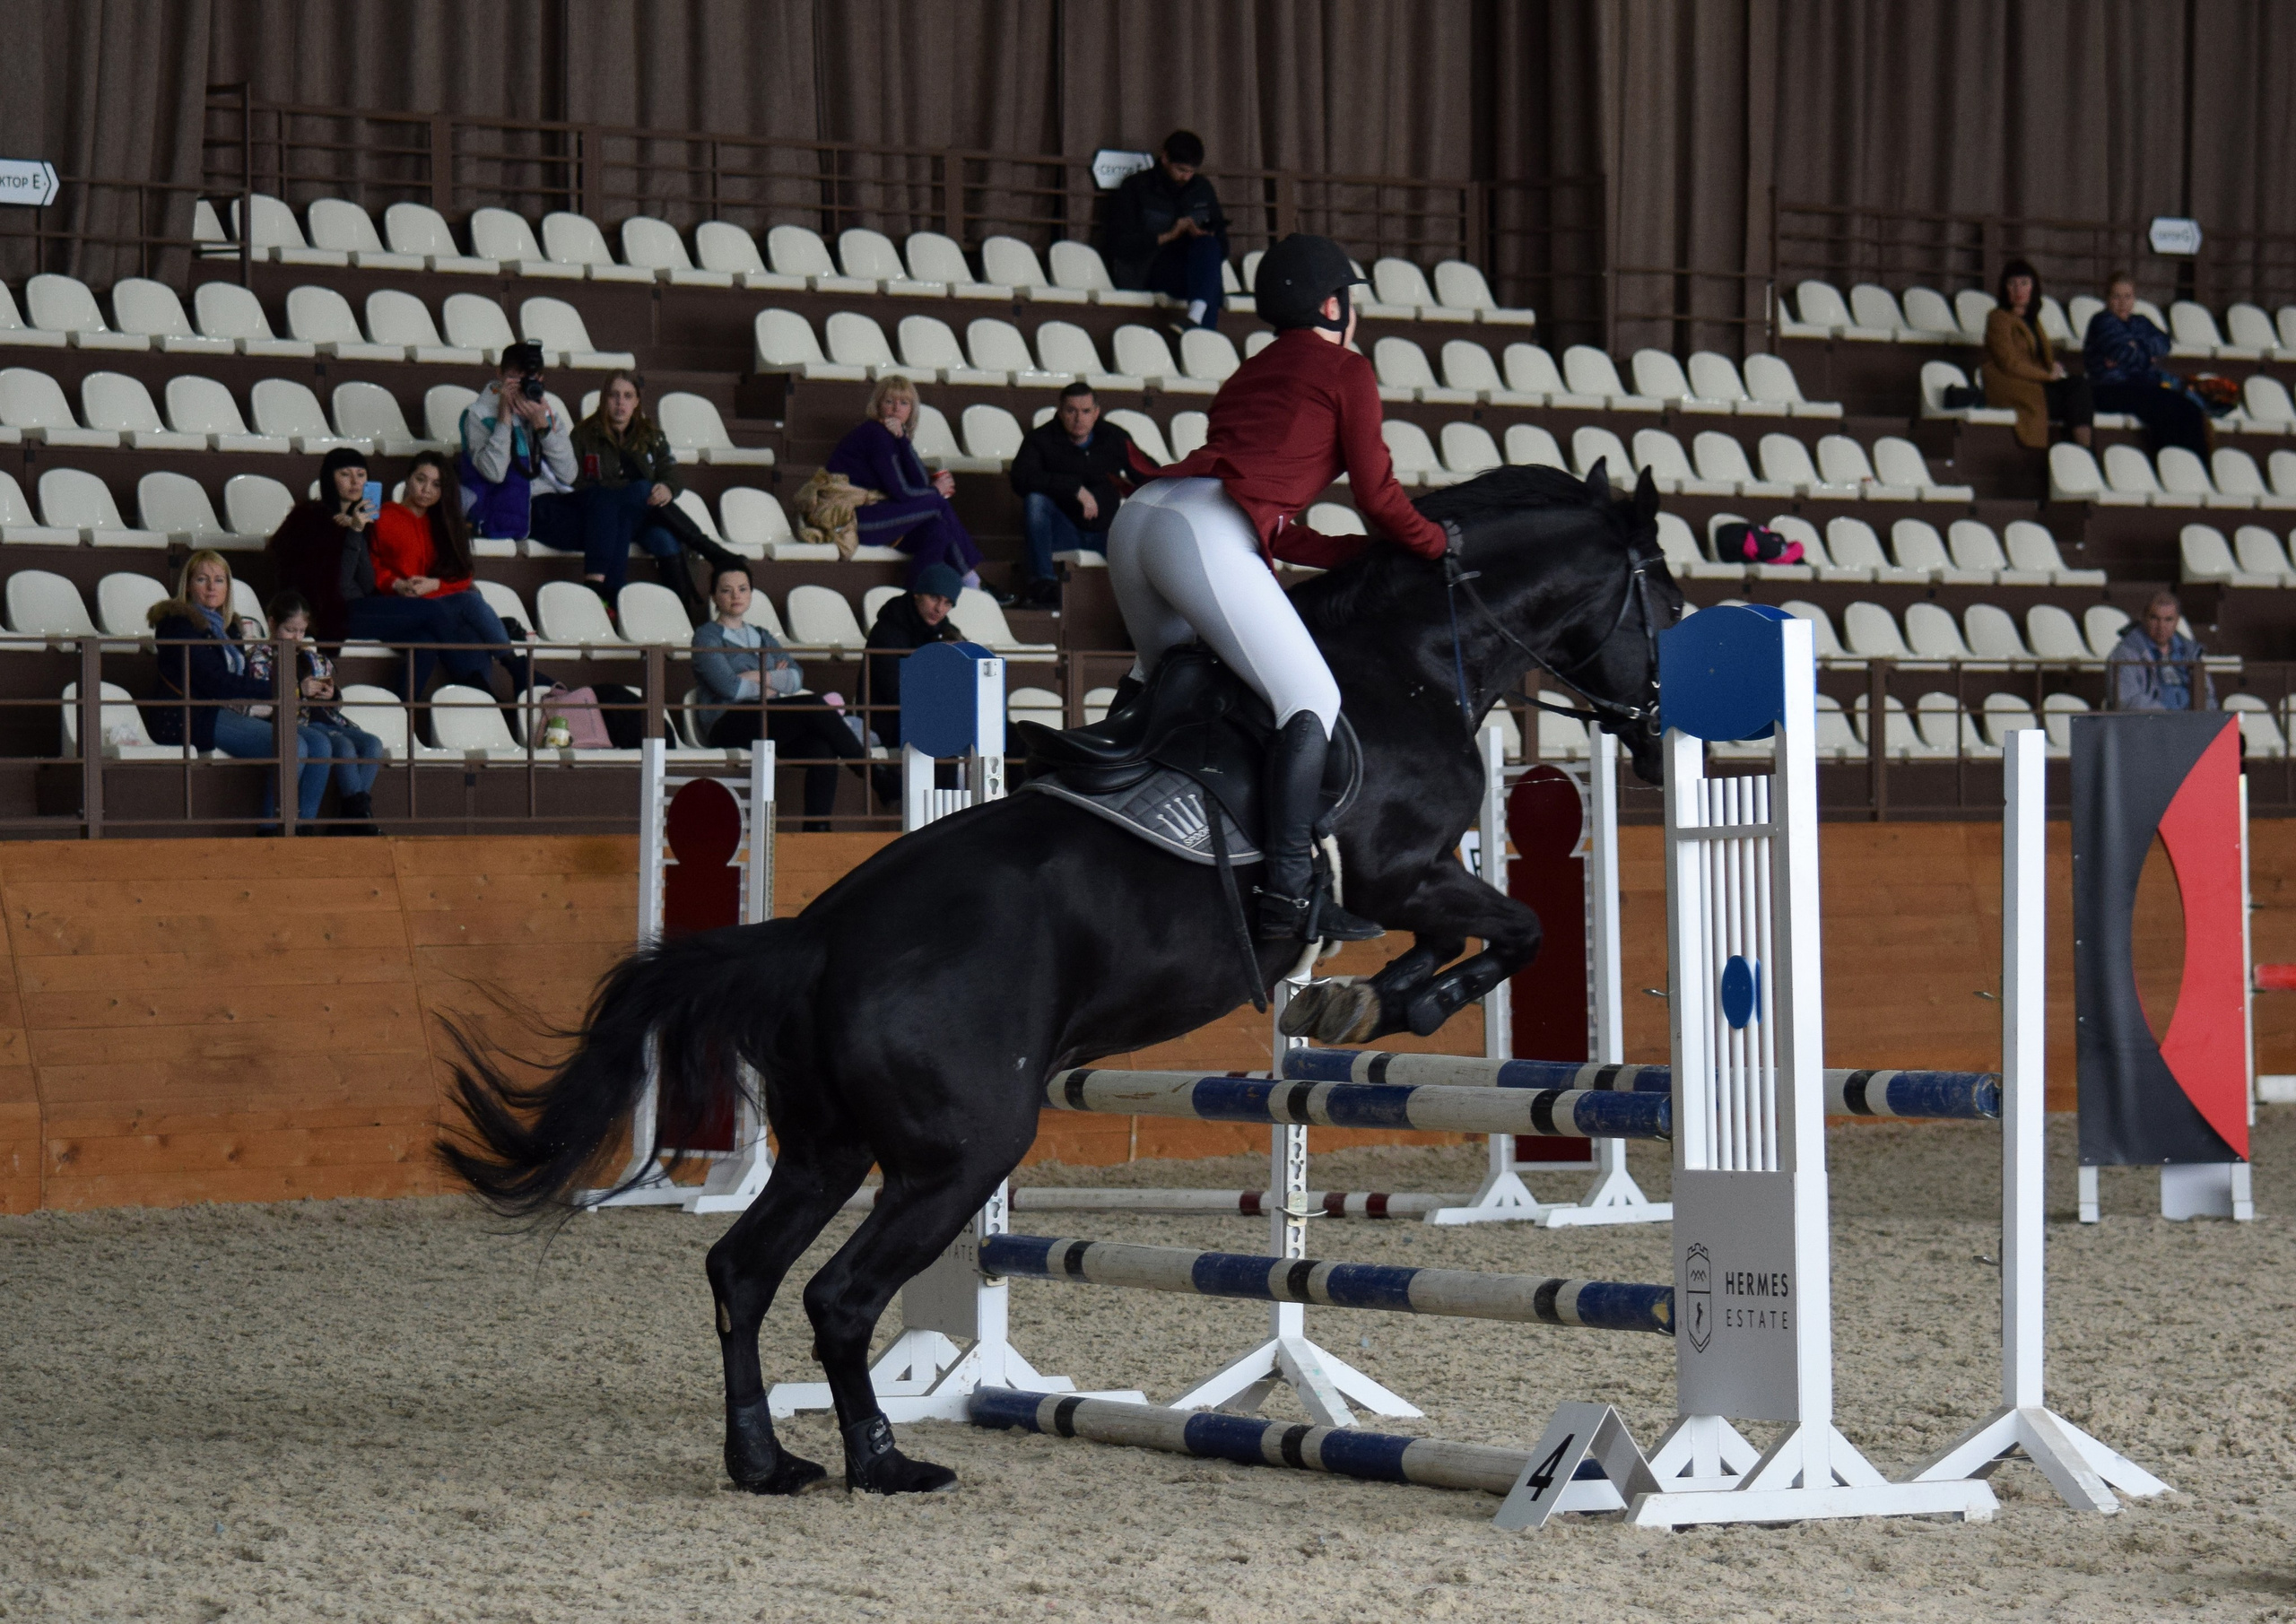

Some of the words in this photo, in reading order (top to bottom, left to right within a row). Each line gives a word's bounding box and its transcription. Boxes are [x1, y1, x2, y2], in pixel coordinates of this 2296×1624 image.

[0, 176, 28, 188] КТОР
[32, 173, 40, 189] E
[1183, 825, 1210, 847] SPOOK
[1726, 1272, 1788, 1298] HERMES
[1726, 1308, 1788, 1330] ESTATE
[1526, 1433, 1576, 1502] 4
